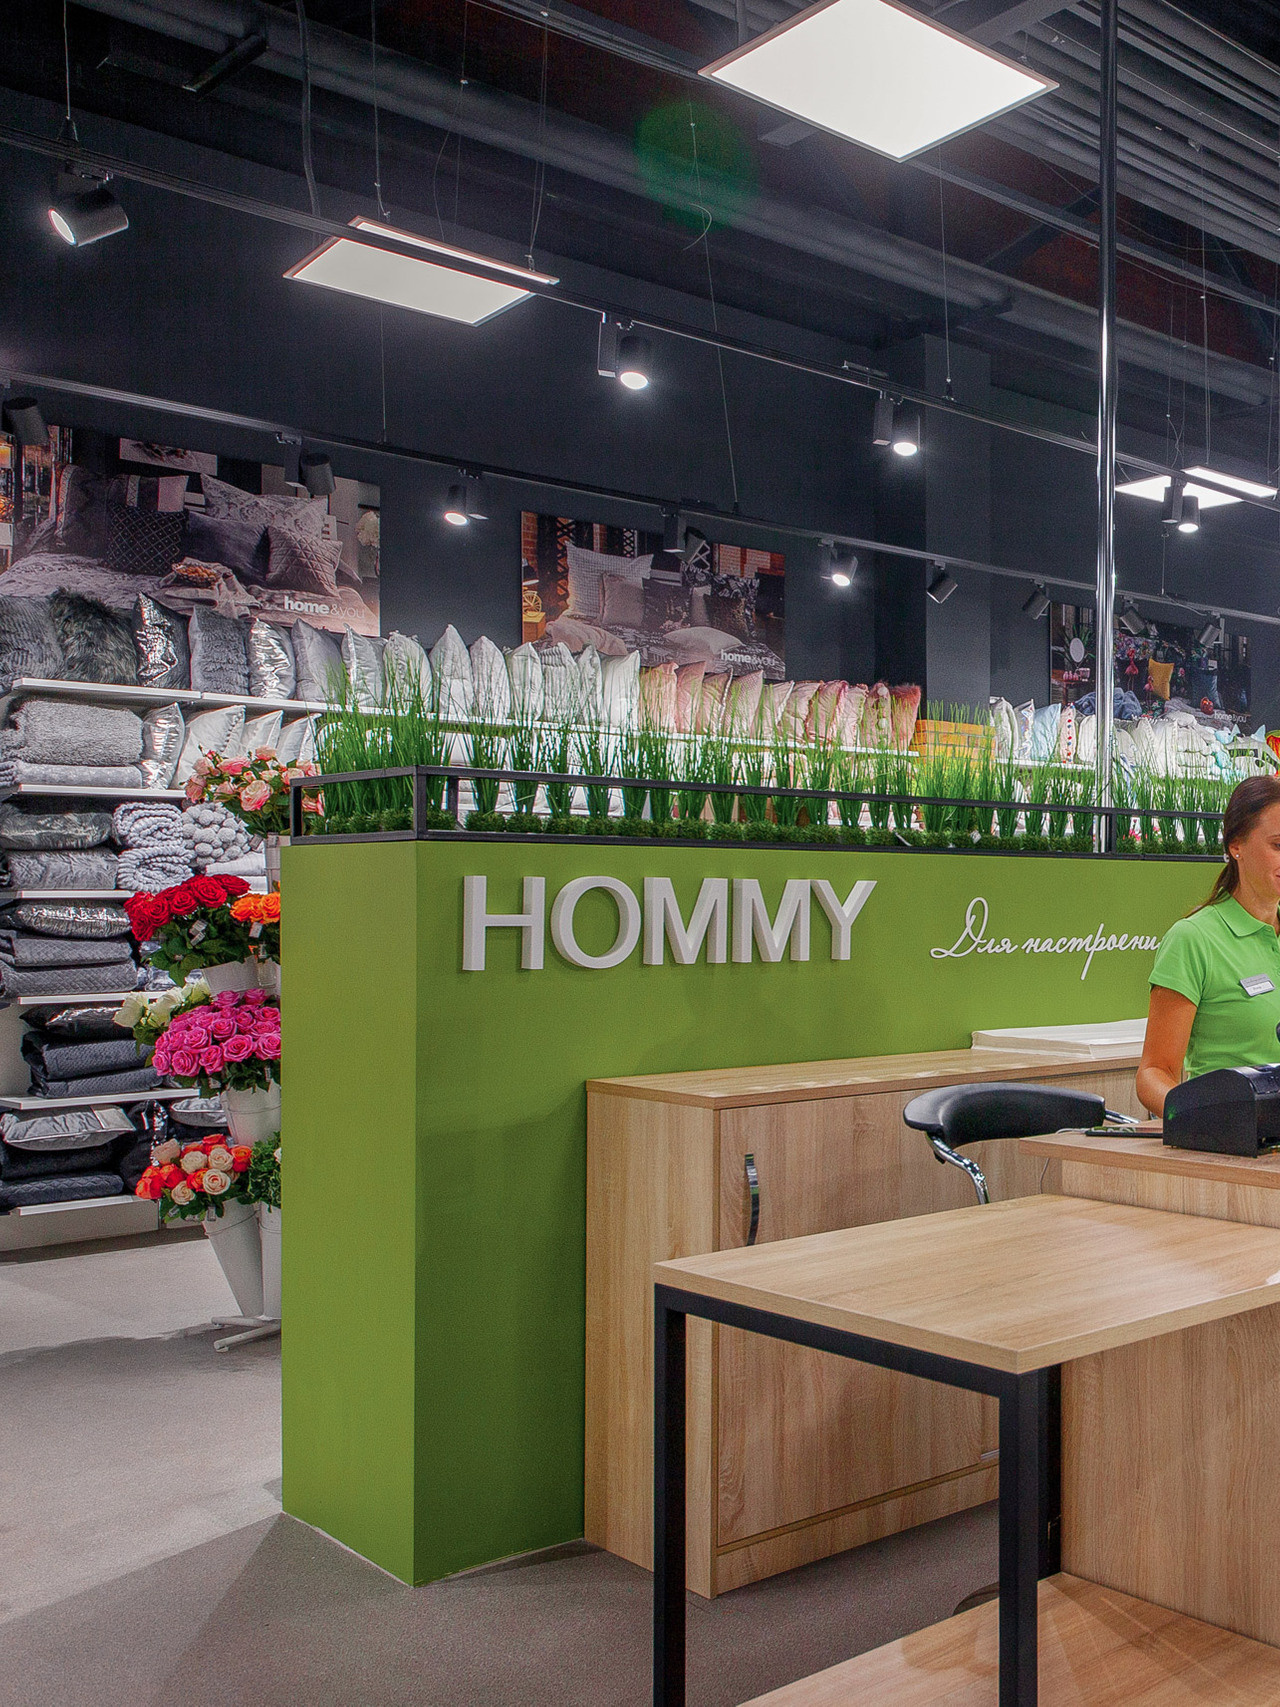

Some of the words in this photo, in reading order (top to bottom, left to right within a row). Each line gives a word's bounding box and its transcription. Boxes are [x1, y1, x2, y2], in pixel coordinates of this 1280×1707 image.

[284, 595, 366, 619] home&you
[720, 648, 775, 666] home&you
[462, 875, 878, 971] HOMMY
[930, 896, 1019, 959] Для
[1021, 923, 1163, 981] настроени
